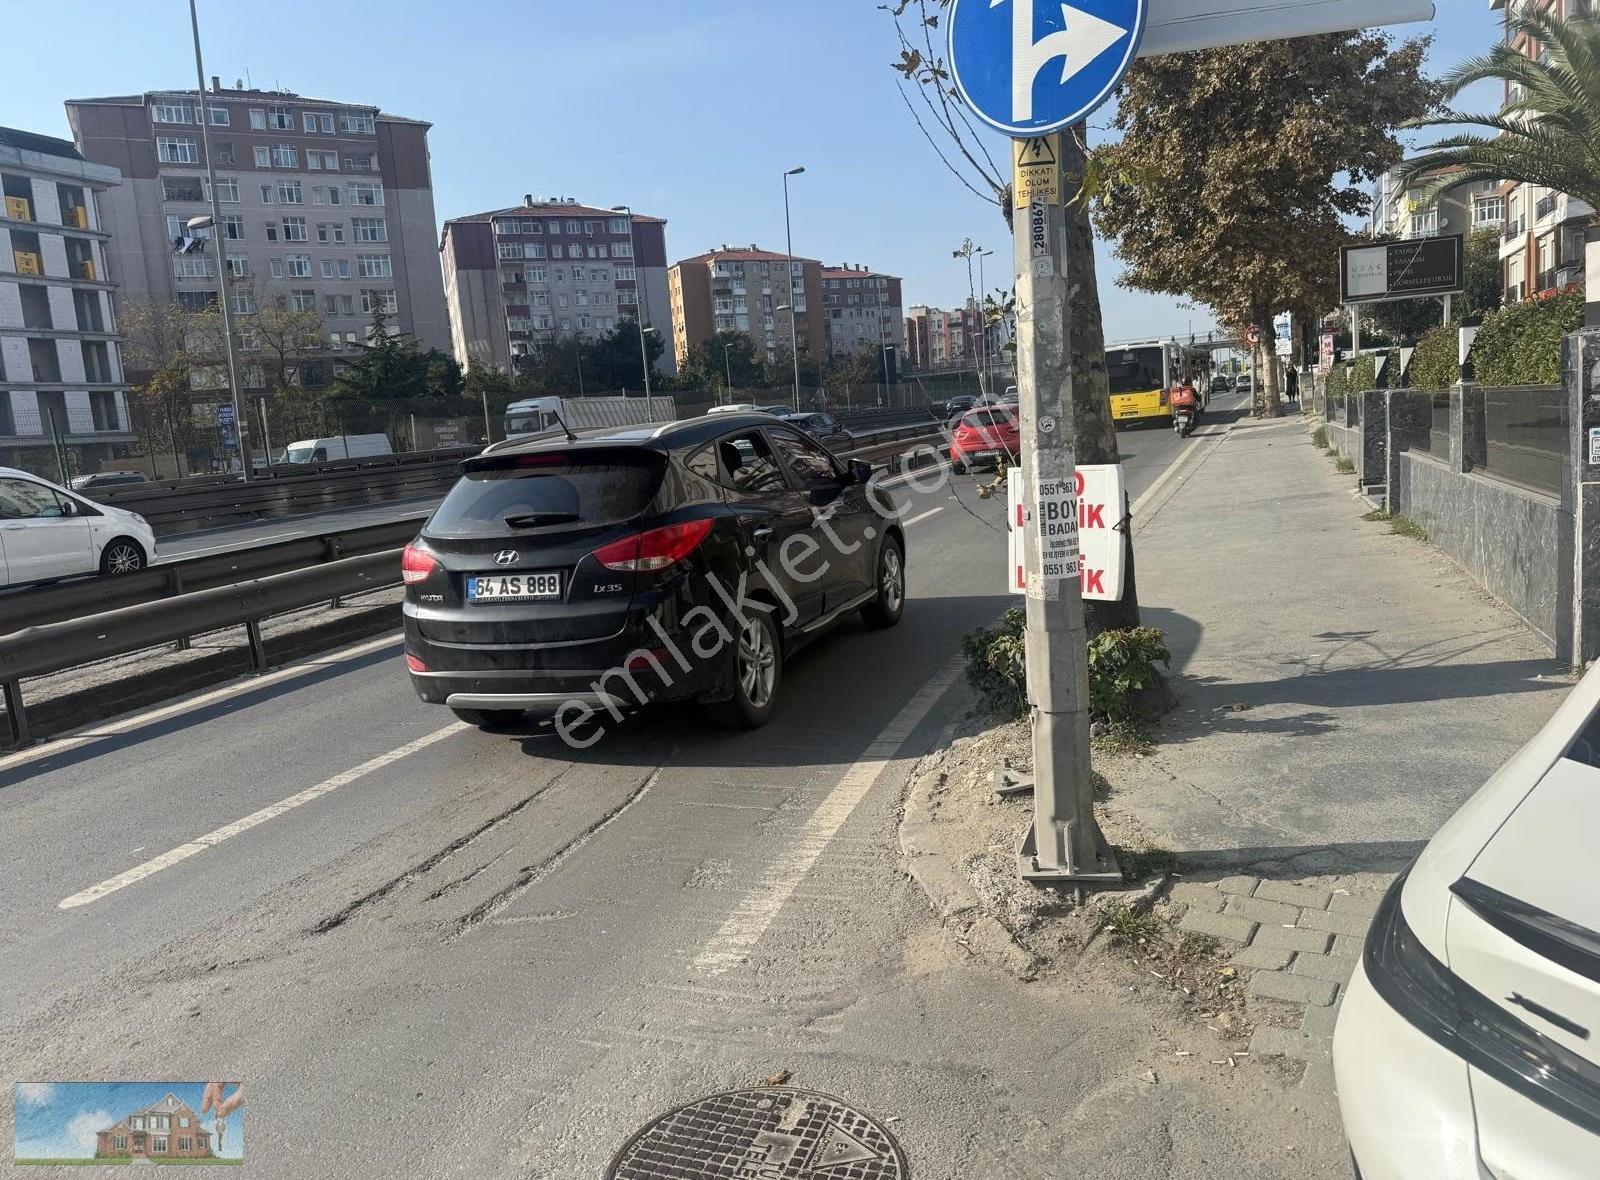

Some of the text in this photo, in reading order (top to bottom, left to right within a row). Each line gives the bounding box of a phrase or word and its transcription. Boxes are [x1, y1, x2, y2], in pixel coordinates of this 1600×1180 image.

[1033, 201, 1045, 249] 280867
[1039, 483, 1059, 496] 0551
[1043, 563, 1063, 575] 0551
[476, 578, 494, 597] 64
[499, 576, 522, 596] AS
[526, 575, 557, 594] 888
